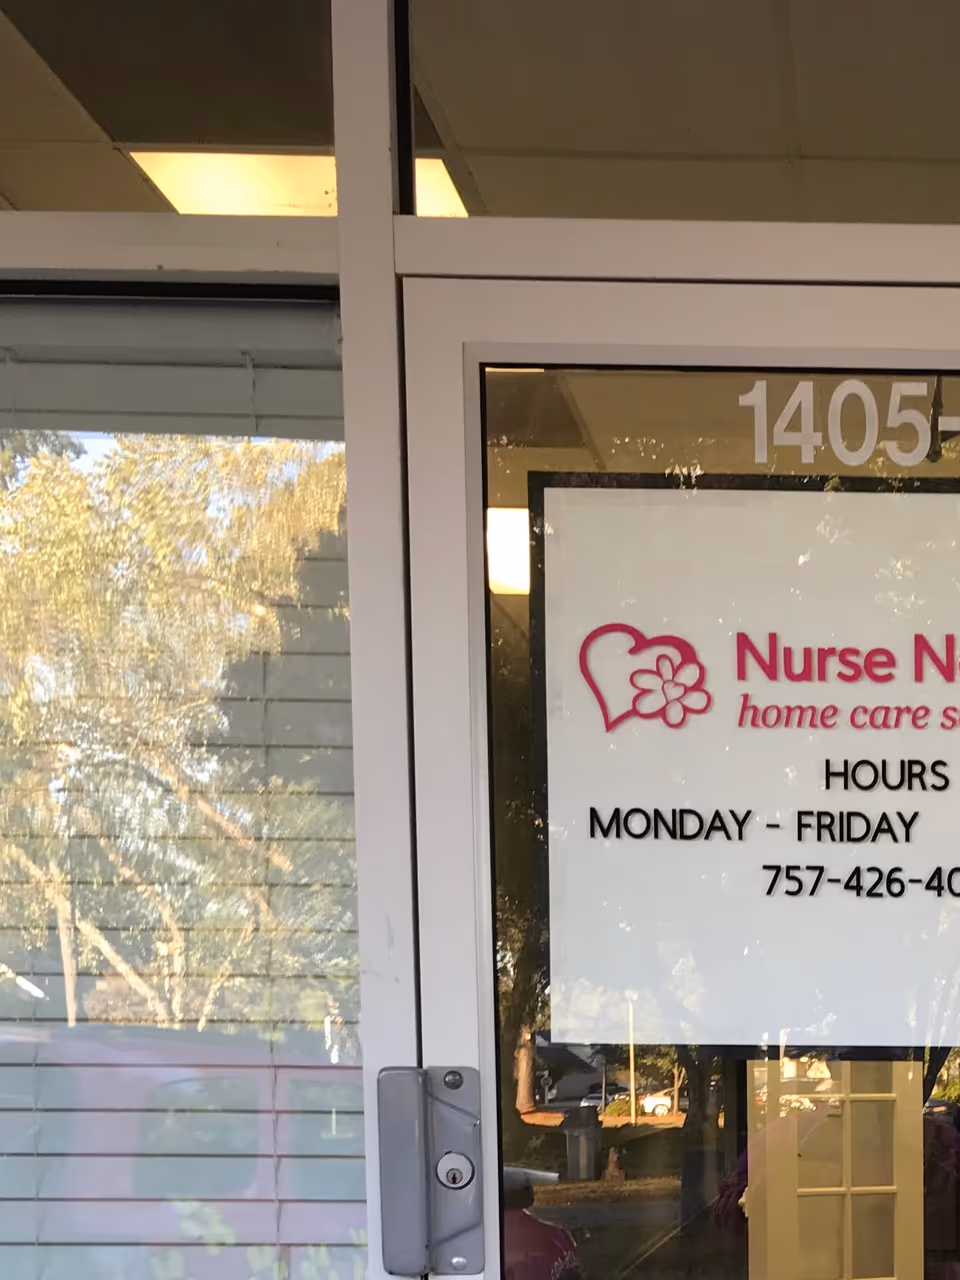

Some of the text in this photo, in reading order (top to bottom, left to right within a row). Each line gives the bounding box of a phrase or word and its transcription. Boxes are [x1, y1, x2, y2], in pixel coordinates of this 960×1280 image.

[735, 633, 897, 685] Nurse
[738, 694, 839, 729] home
[849, 699, 930, 730] care
[823, 759, 951, 793] HOURS
[588, 807, 752, 841] MONDAY
[796, 811, 920, 844] FRIDAY
